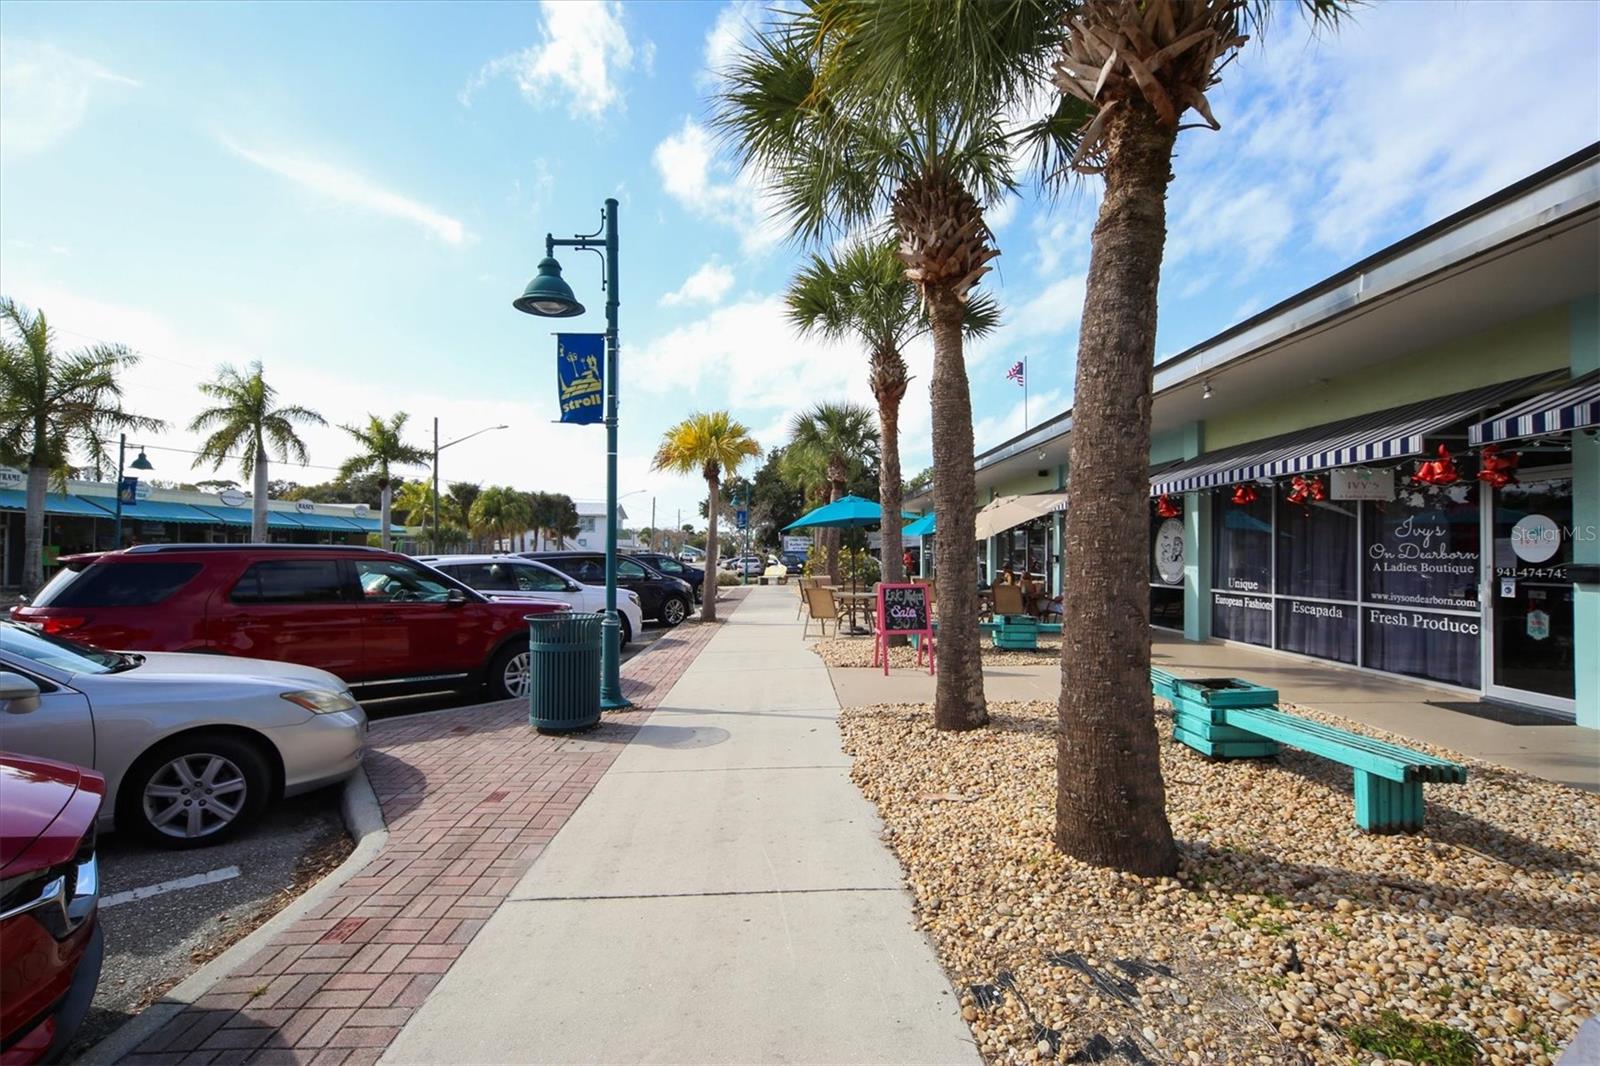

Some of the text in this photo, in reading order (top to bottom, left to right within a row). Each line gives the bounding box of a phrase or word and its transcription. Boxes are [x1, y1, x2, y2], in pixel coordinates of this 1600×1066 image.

[0, 472, 21, 482] RAME
[1394, 515, 1446, 548] Ivy's
[1369, 542, 1479, 560] On Dearborn
[1373, 562, 1475, 575] A Ladies Boutique
[1228, 577, 1259, 591] Unique
[1215, 594, 1273, 611] European Fashions
[1371, 592, 1476, 608] www.ivysondearborn.com
[890, 604, 917, 618] Sale
[1292, 601, 1343, 618] Escapada
[1370, 609, 1479, 635] Fresh Produce
